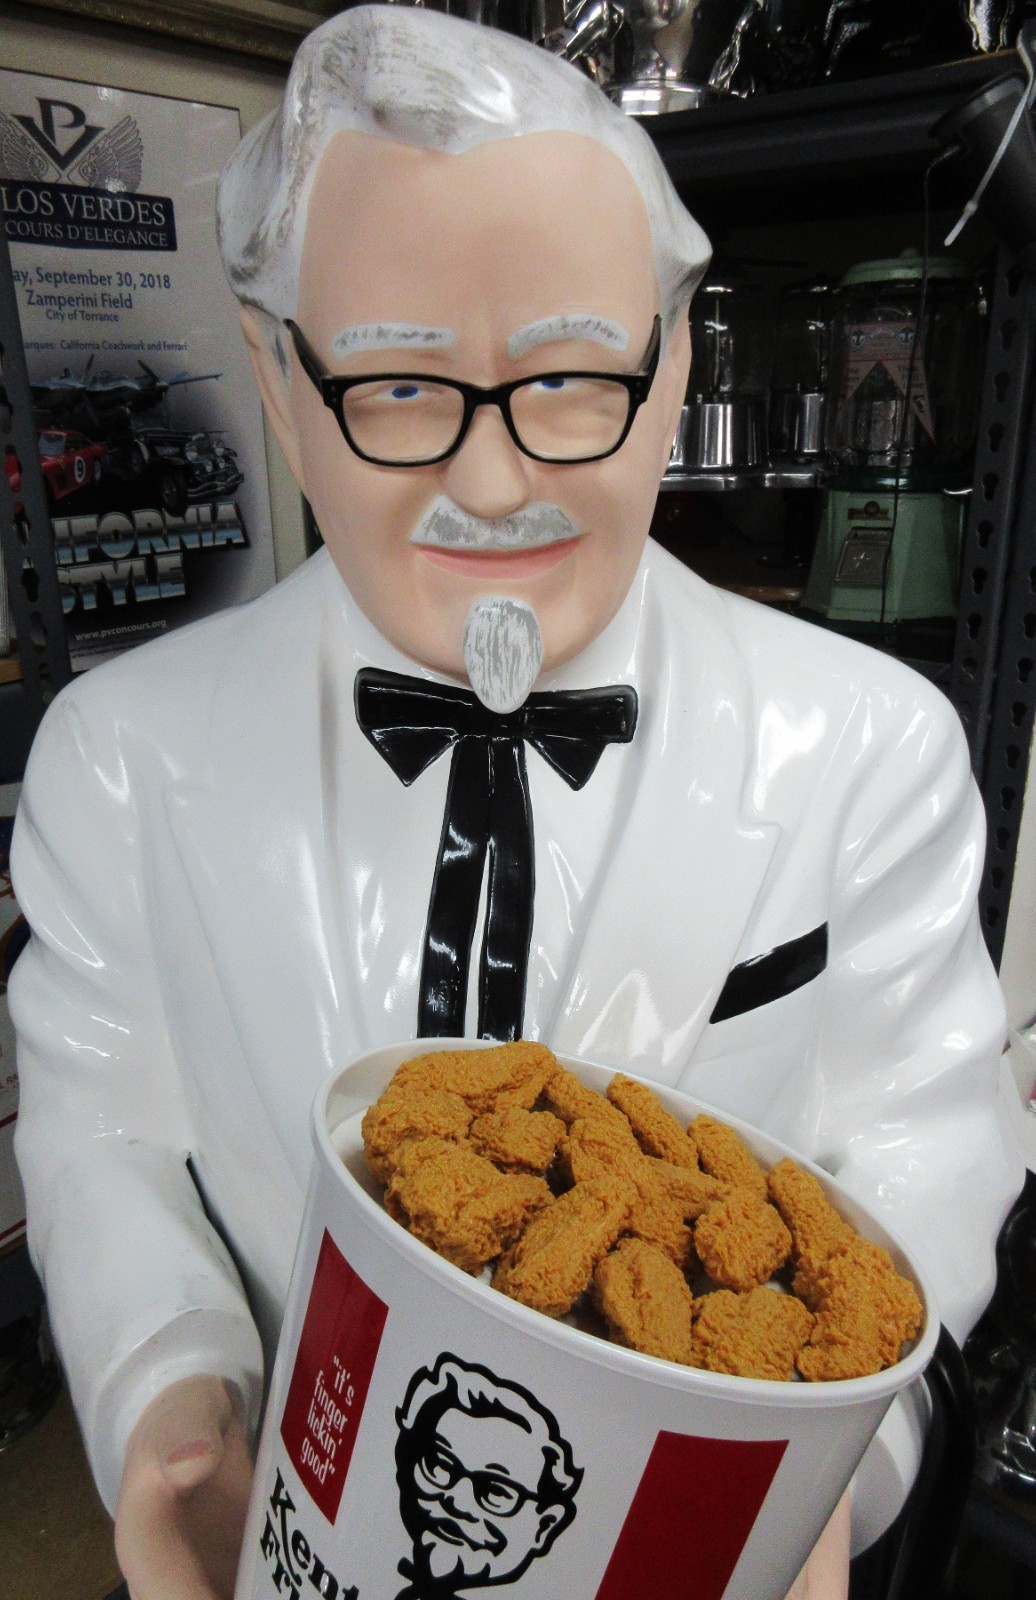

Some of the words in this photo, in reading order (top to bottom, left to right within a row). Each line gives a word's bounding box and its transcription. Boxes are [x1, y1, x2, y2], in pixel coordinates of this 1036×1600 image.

[0, 187, 55, 217] LOS
[60, 193, 166, 227] VERDES
[5, 220, 64, 240] COURS
[67, 225, 169, 248] D'ELEGANCE
[36, 266, 112, 289] September
[116, 271, 137, 290] 30,
[140, 273, 171, 289] 2018
[25, 289, 98, 311] Zamperini
[101, 292, 133, 310] Field
[46, 310, 65, 323] City
[68, 310, 78, 321] of
[79, 310, 119, 322] Torrance
[60, 339, 100, 350] California
[101, 340, 144, 351] Coachwork
[146, 340, 162, 351] and
[163, 341, 187, 351] Ferrari
[52, 501, 246, 564] IFORNIA
[75, 618, 167, 640] www.pvconcours.org
[333, 1354, 355, 1407] "it's
[313, 1369, 348, 1433] finger
[307, 1397, 342, 1460] lickin'
[300, 1436, 336, 1486] good"
